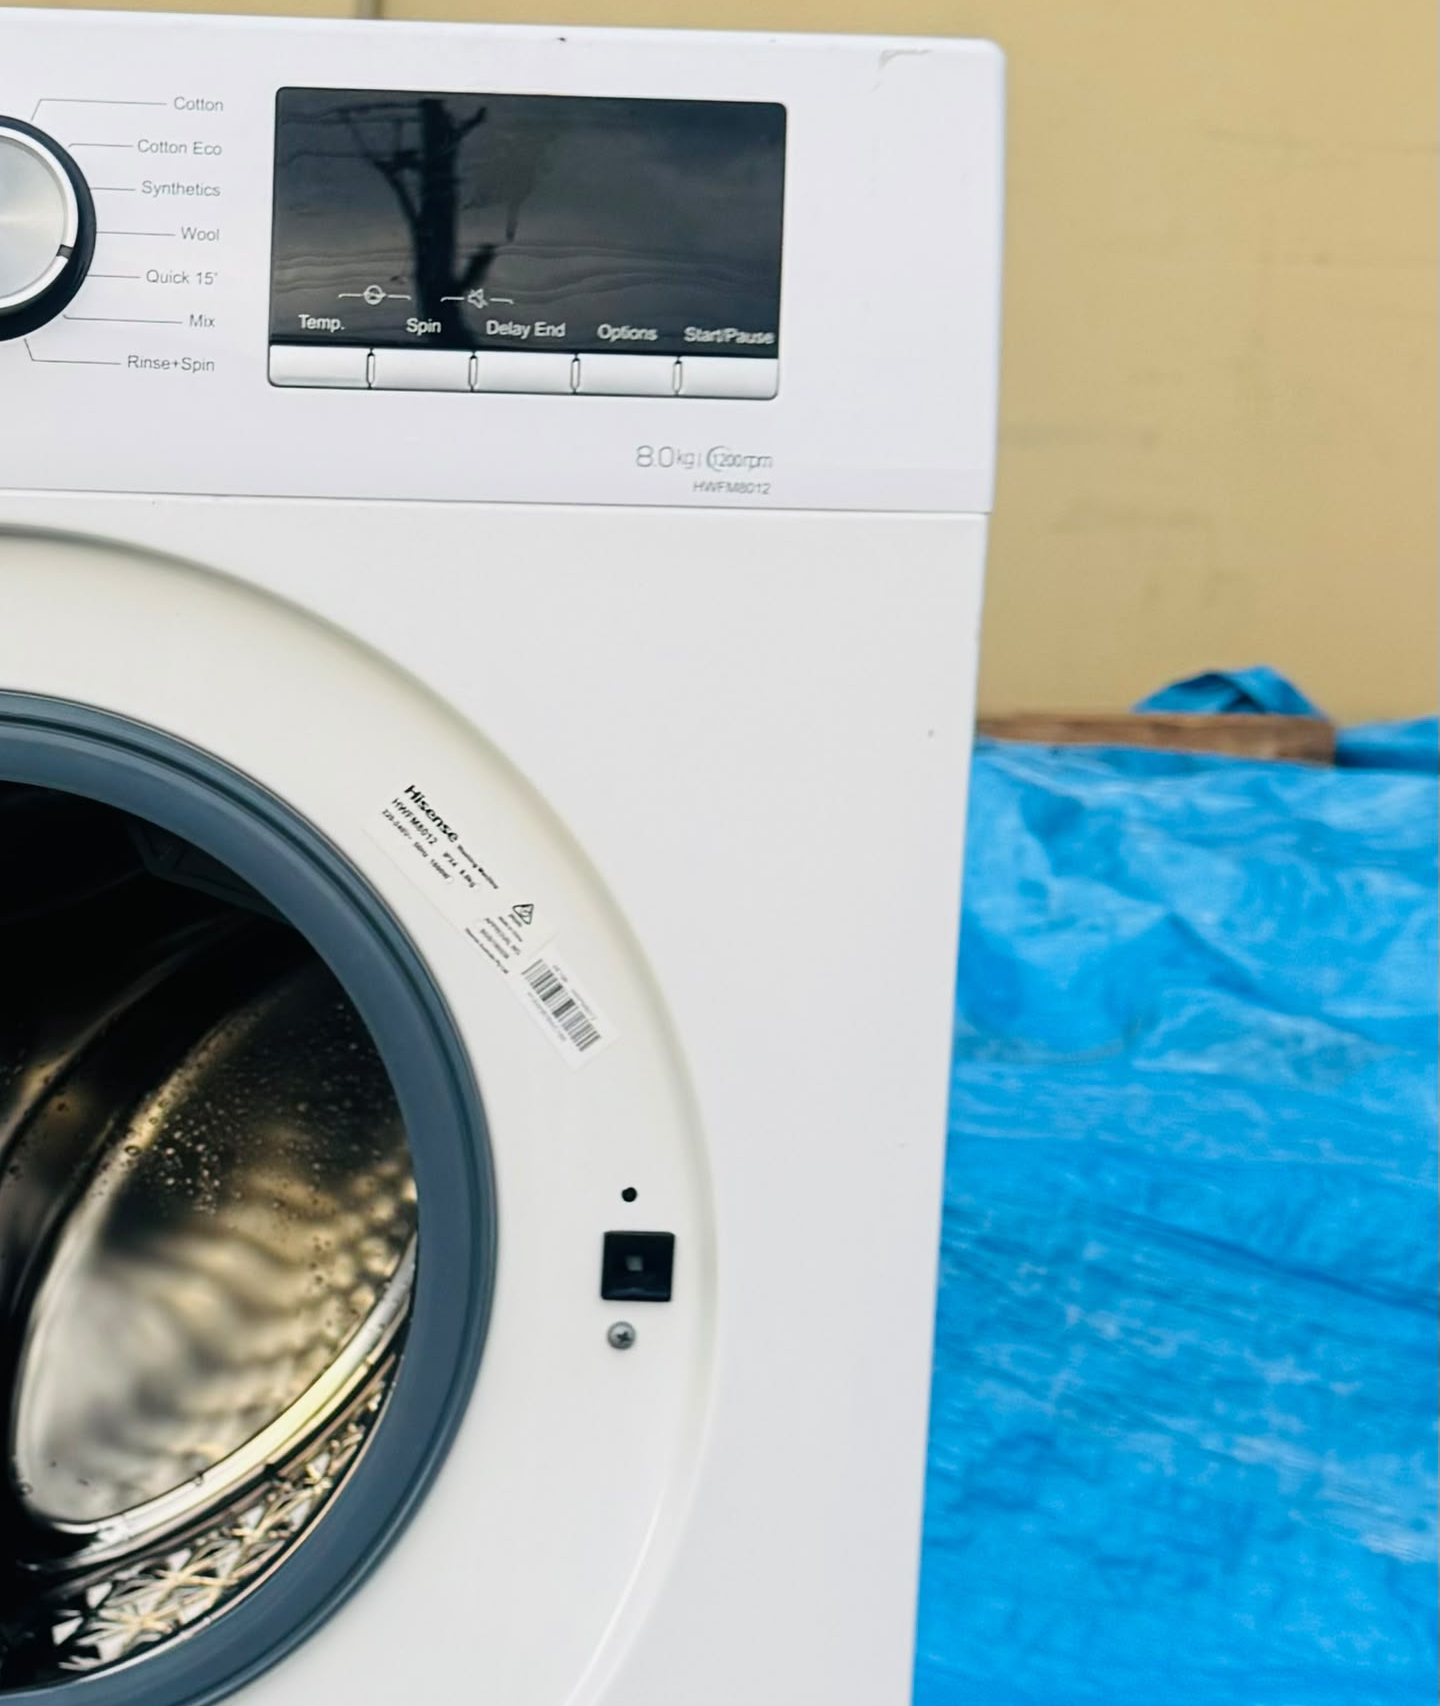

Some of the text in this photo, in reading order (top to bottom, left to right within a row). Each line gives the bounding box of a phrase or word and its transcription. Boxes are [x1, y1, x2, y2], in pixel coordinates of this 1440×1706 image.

[173, 97, 224, 112] Cotton
[137, 139, 222, 156] Cotton Eco
[141, 180, 221, 198] Synthetics
[181, 227, 220, 242] Wool
[146, 269, 190, 285] Quick
[189, 314, 216, 329] Mix
[298, 314, 345, 334] Temp.
[406, 317, 442, 336] Spin
[486, 319, 565, 339] Delay End
[598, 323, 658, 343] Options
[683, 326, 775, 345] Start/Pause
[127, 355, 215, 374] Rinse+Spin
[404, 784, 459, 843] Hisense
